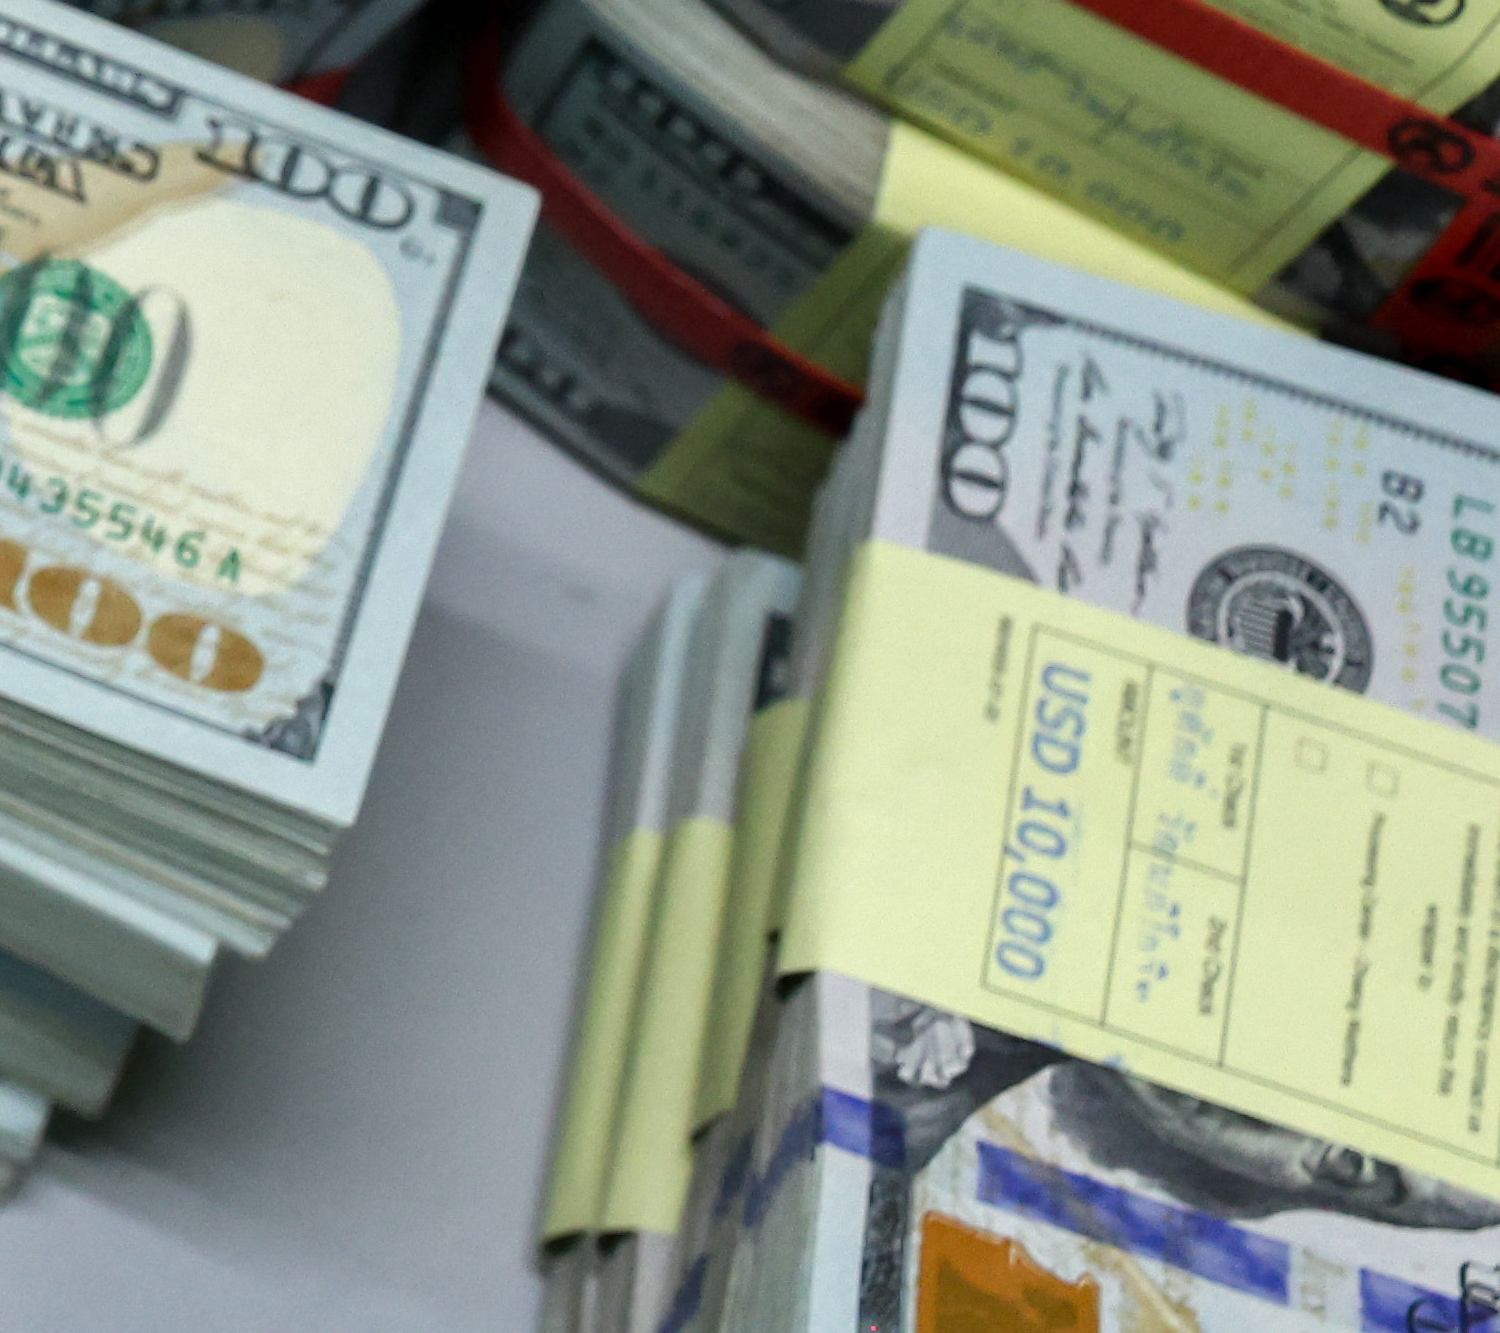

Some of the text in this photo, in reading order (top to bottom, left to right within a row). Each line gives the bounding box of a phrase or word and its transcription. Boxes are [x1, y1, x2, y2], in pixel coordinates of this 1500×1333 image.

[190, 113, 414, 233] 100
[949, 332, 1025, 522] 100
[1378, 469, 1425, 535] B2
[1436, 491, 1496, 730] LB95507
[995, 661, 1093, 981] USD 10,000
